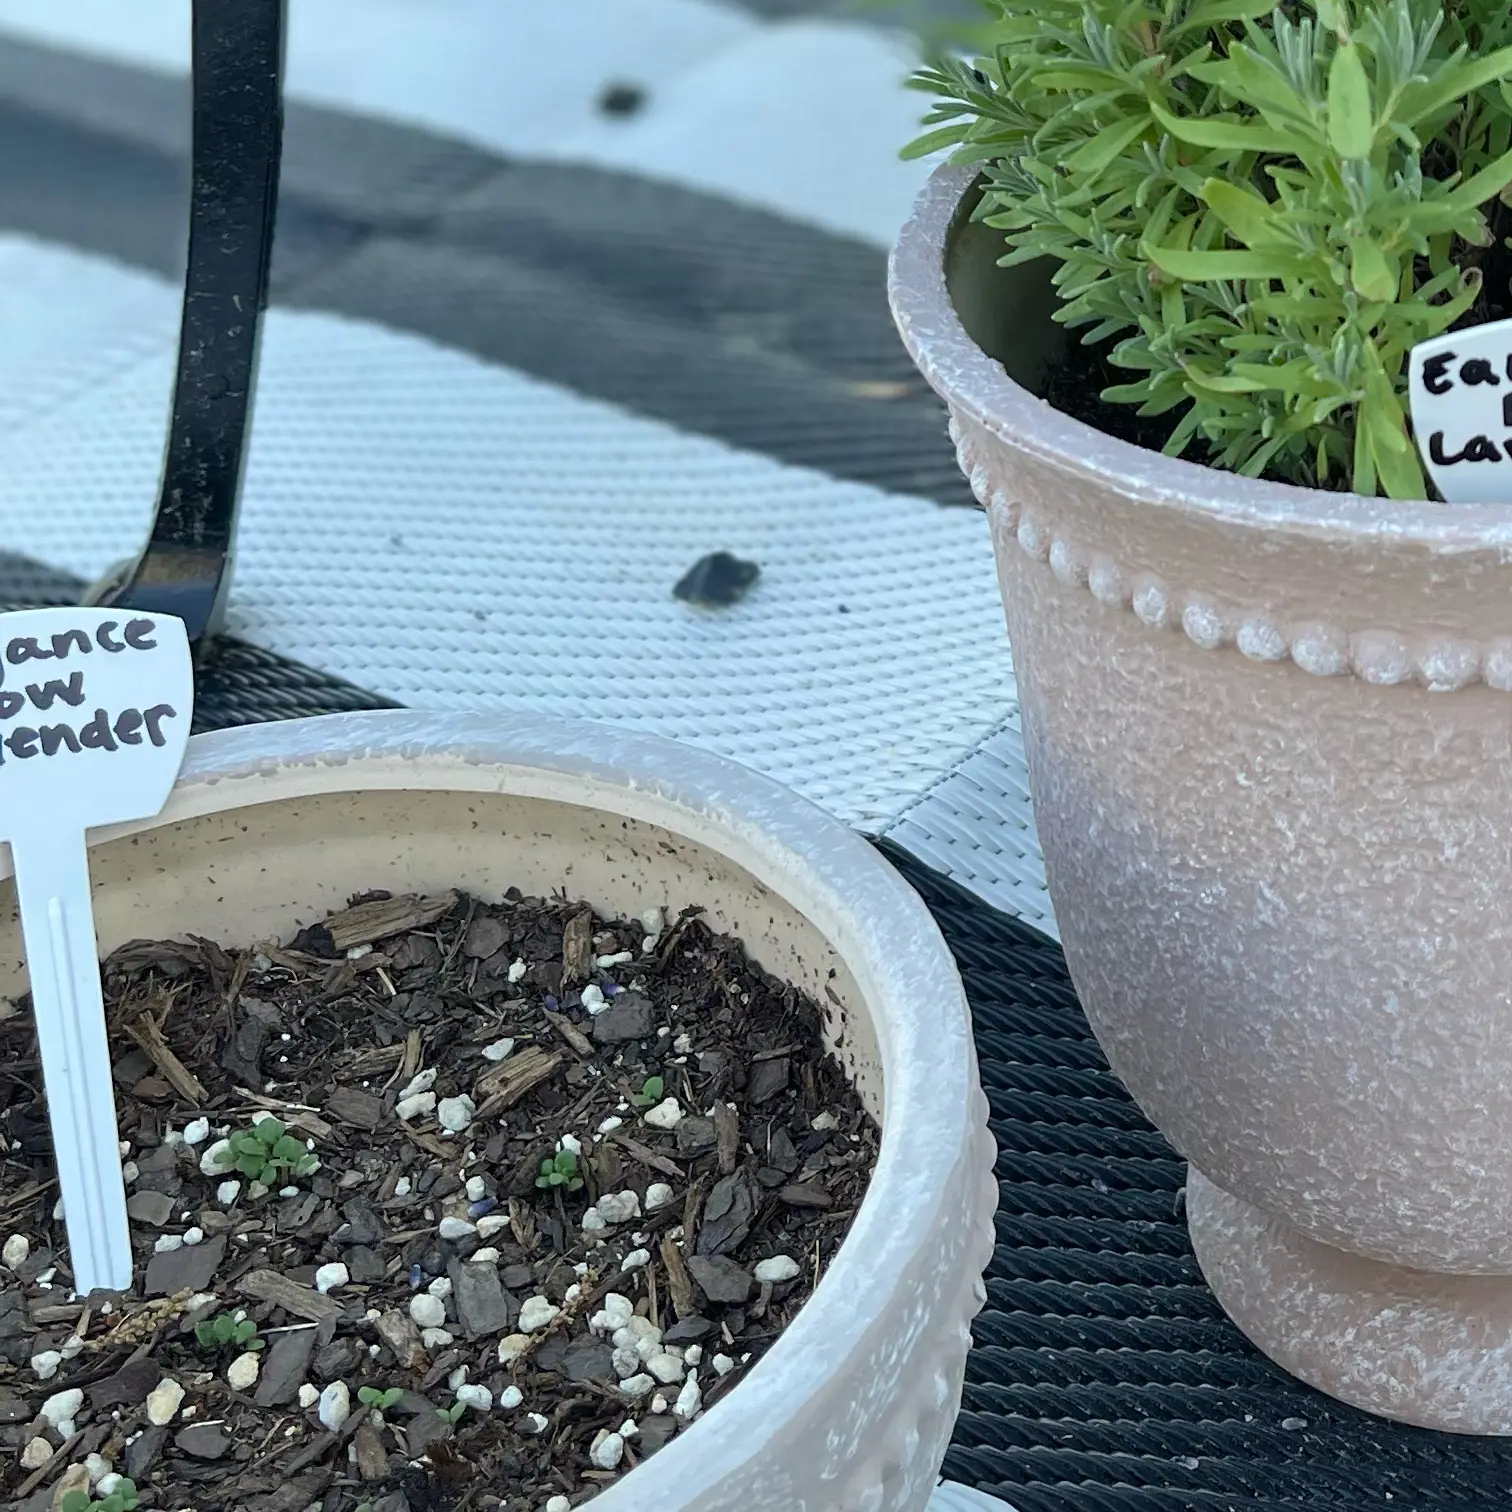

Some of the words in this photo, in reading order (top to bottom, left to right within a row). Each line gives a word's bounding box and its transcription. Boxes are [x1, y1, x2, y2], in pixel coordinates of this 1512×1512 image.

[0, 617, 158, 680] ance
[0, 671, 87, 720] ow
[0, 703, 178, 767] ender
